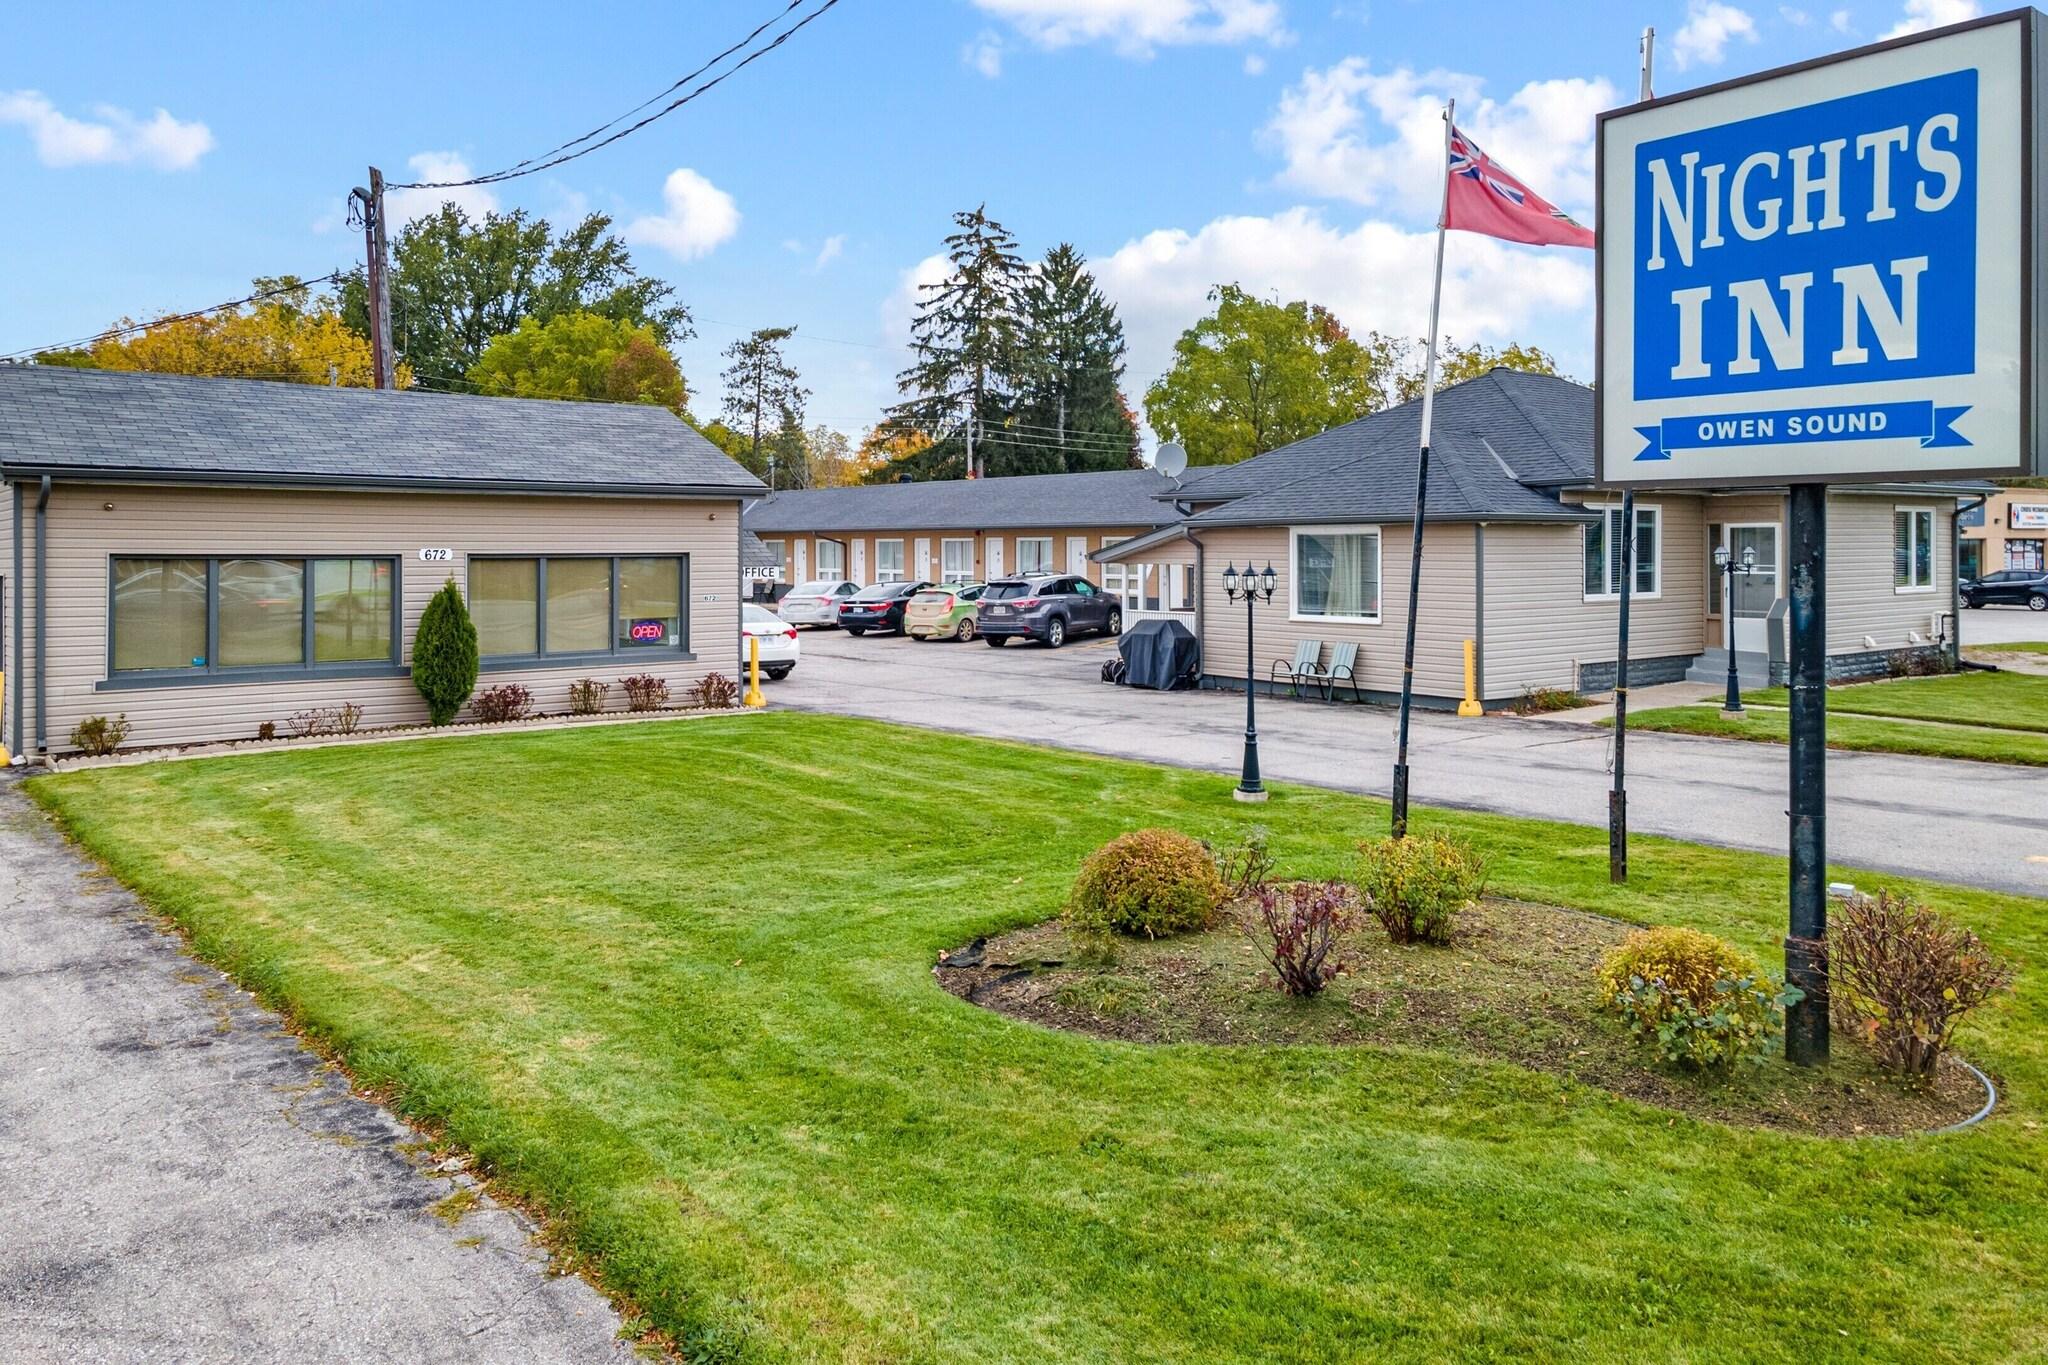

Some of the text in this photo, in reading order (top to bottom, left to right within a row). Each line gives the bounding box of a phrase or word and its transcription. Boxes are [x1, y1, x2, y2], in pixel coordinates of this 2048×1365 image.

[1647, 113, 1962, 271] NIGHTS
[1670, 255, 1929, 381] INN
[1698, 411, 1887, 441] OWEN SOUND
[424, 549, 447, 560] 672
[742, 567, 775, 578] FFICE
[632, 625, 663, 638] OPEN
